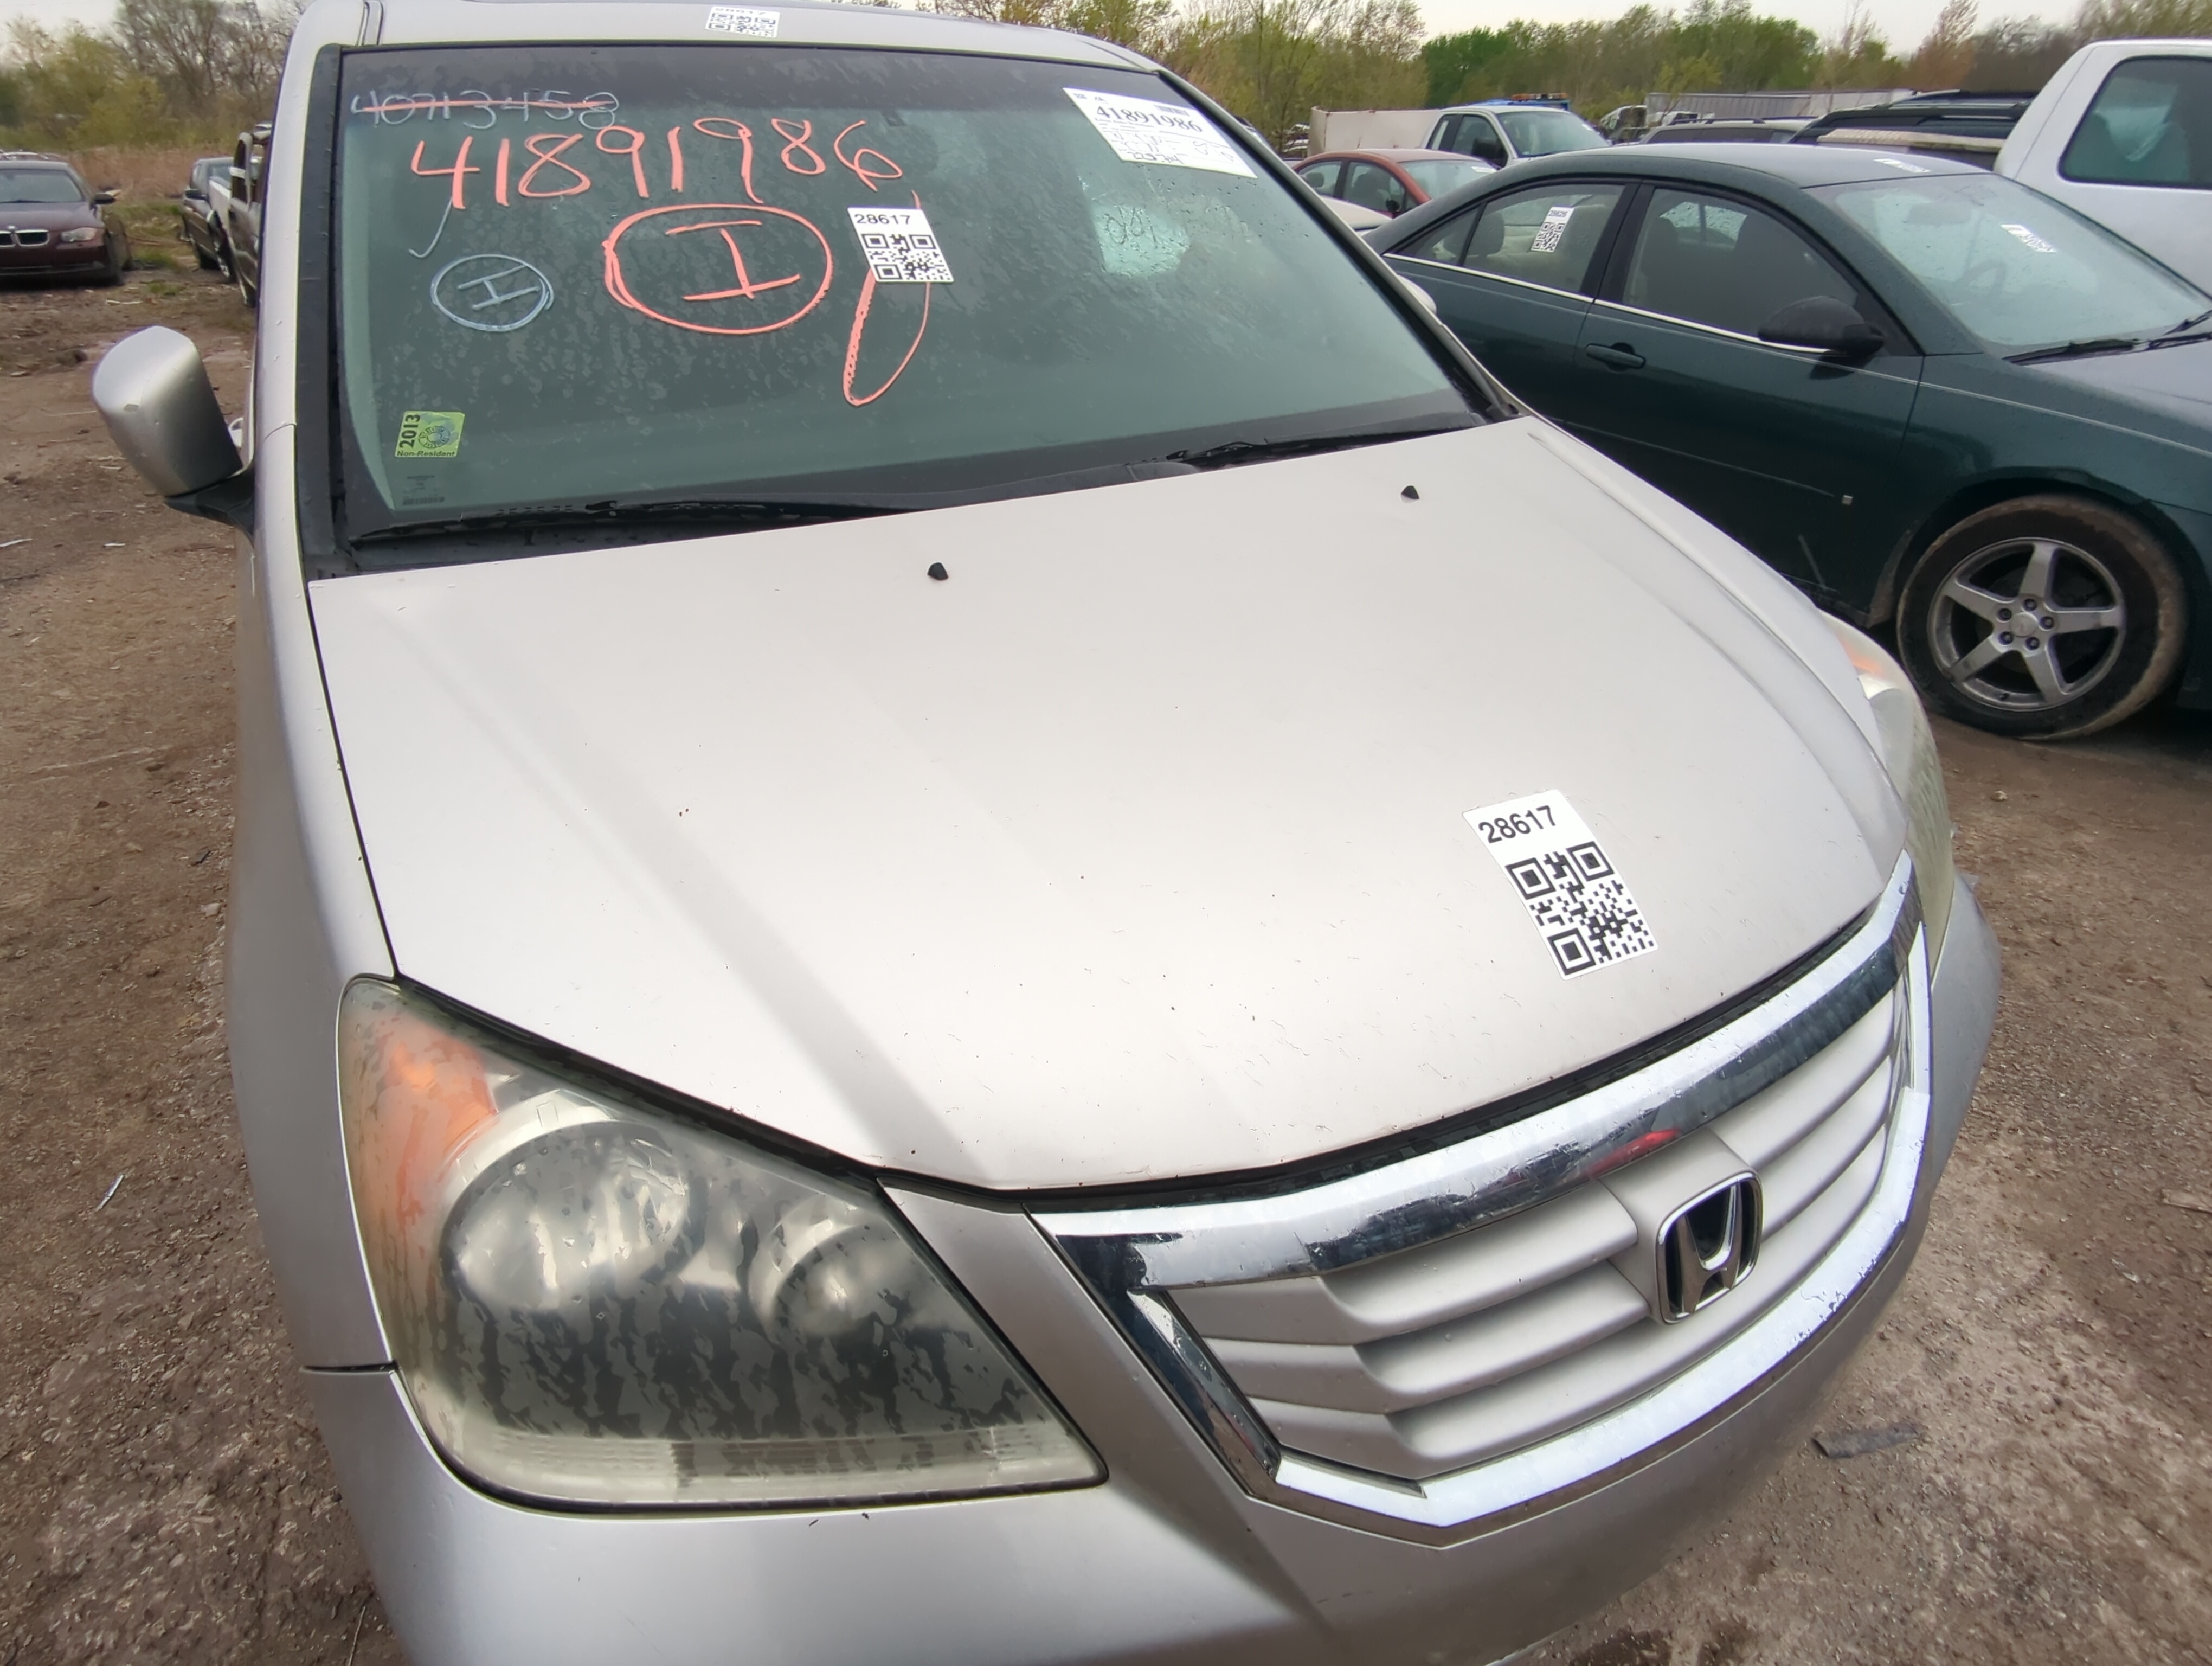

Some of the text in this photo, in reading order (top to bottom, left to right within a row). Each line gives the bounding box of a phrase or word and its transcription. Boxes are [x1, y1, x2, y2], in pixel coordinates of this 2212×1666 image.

[1096, 105, 1204, 133] 41891986
[410, 117, 903, 210] 41891986
[854, 213, 911, 225] 28617
[398, 414, 421, 448] 2013
[1478, 804, 1556, 844] 28617
